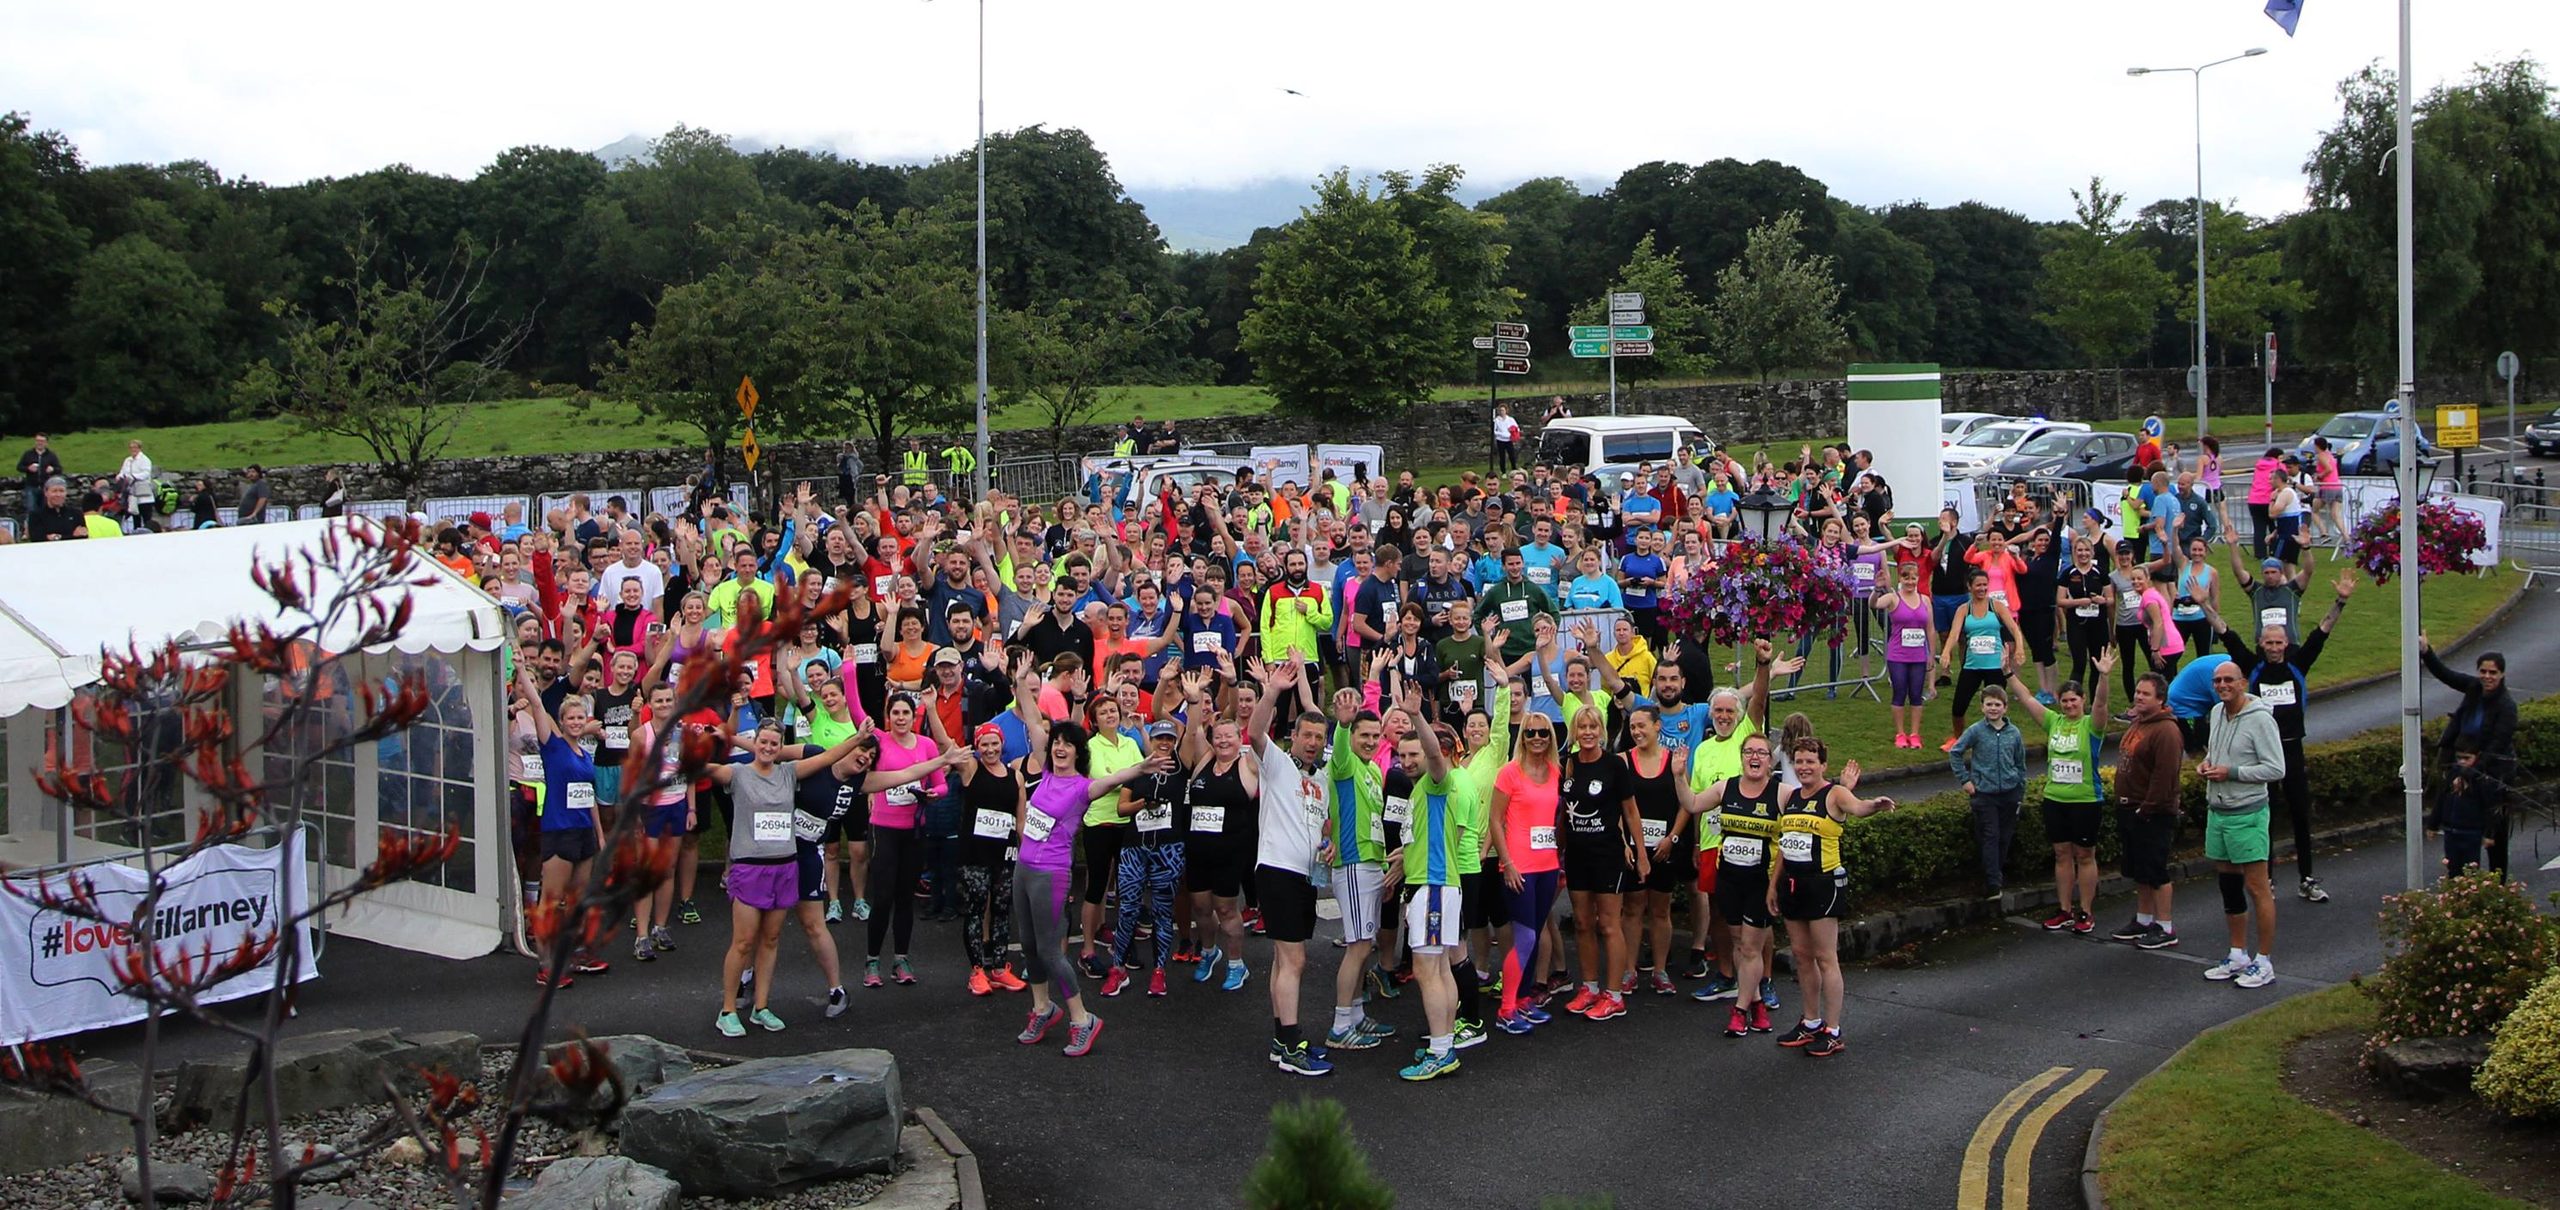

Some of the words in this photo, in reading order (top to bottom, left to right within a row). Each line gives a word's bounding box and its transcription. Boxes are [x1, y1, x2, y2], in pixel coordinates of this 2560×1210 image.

[761, 819, 786, 830] 2694
[982, 814, 1006, 828] 3011
[1728, 844, 1756, 857] 2984
